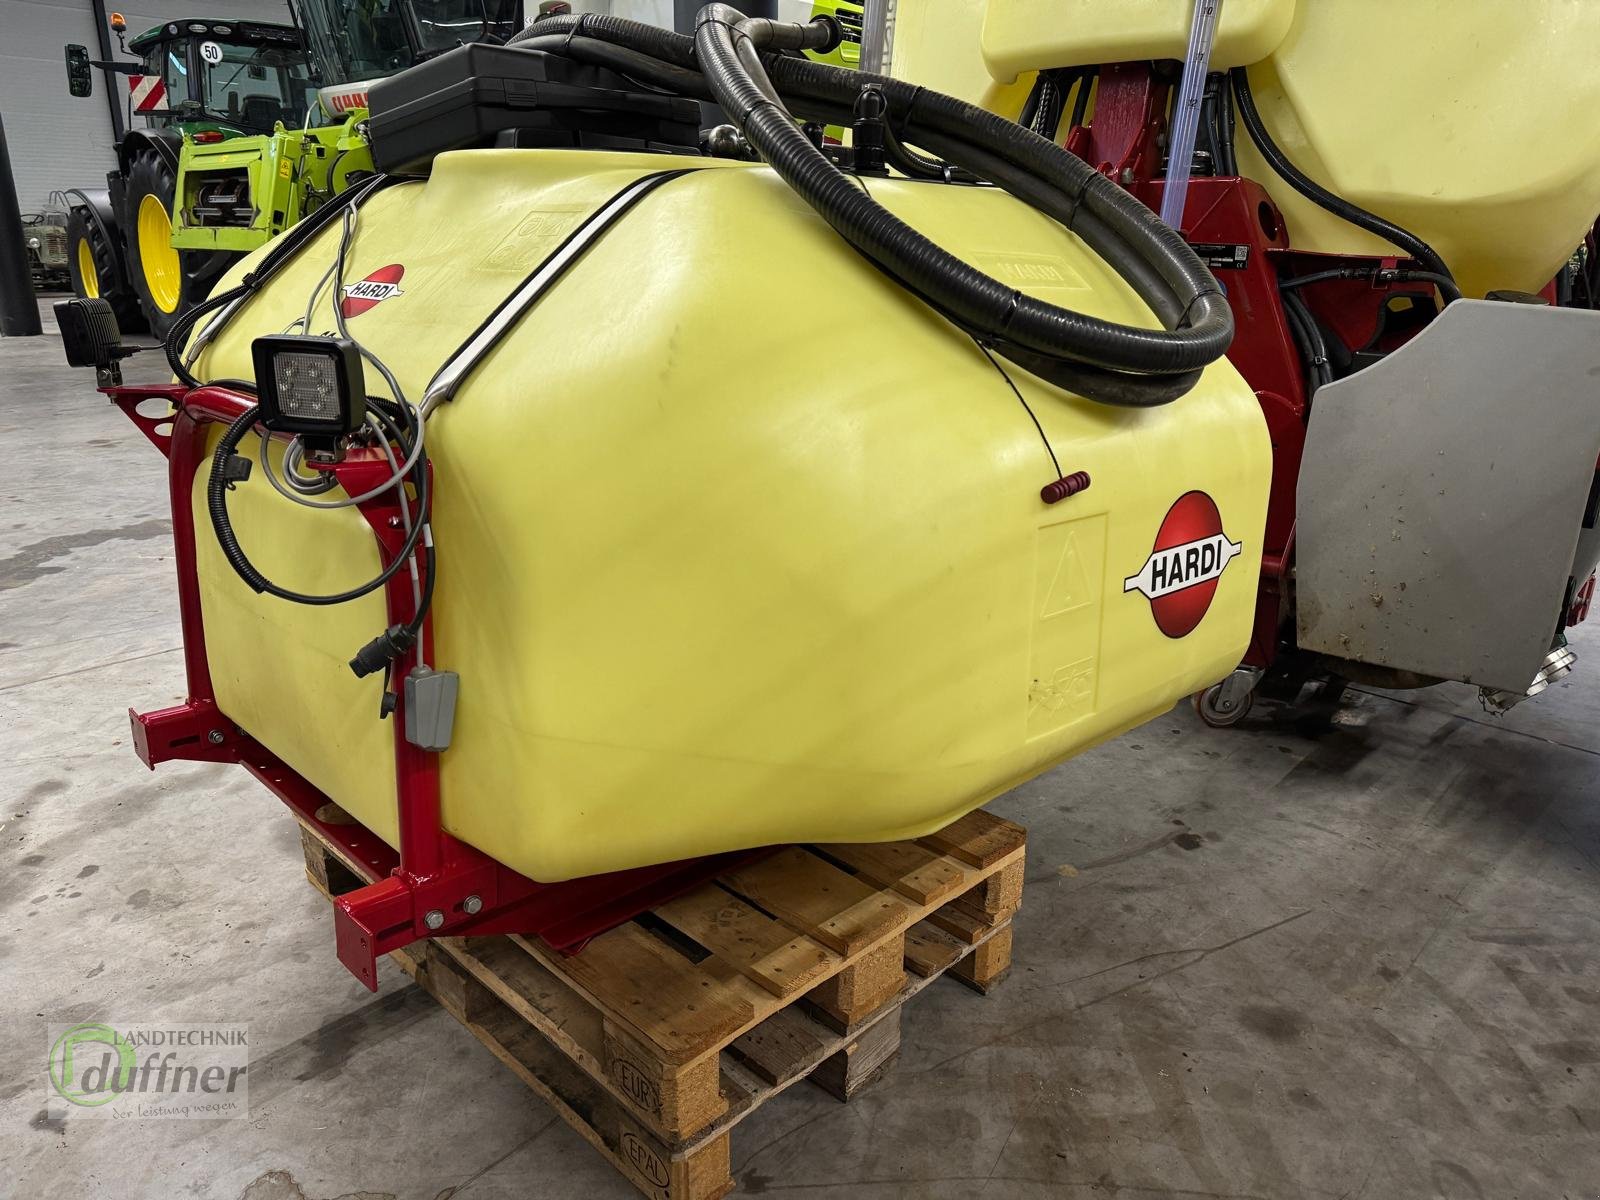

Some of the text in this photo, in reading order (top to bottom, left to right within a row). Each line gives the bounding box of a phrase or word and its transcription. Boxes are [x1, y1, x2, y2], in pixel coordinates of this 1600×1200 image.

[204, 45, 218, 60] 50
[349, 282, 395, 299] HARDI
[1151, 539, 1222, 593] HARDI
[621, 1064, 651, 1108] EUR
[630, 1138, 663, 1184] EPAL
